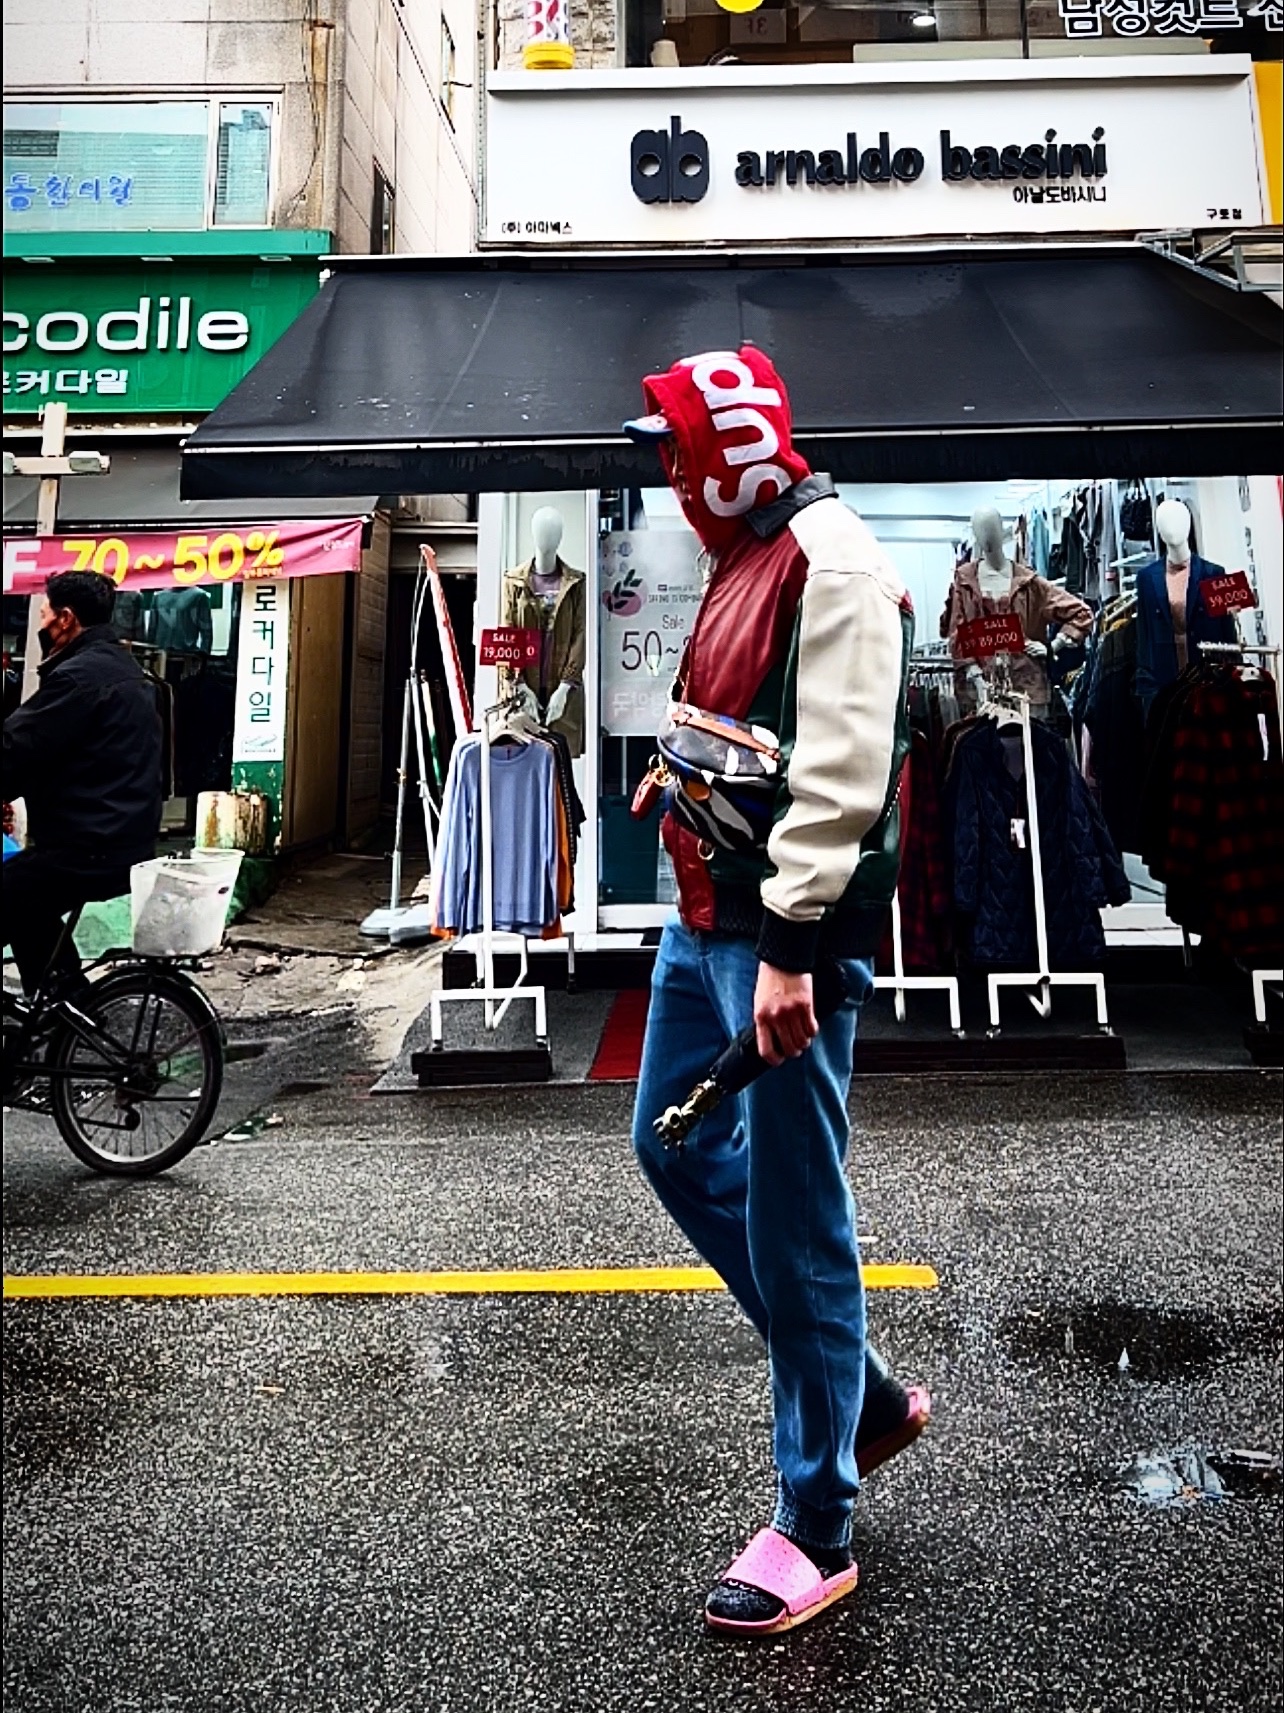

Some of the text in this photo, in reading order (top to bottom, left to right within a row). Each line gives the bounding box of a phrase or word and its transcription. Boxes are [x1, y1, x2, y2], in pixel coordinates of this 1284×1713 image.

[735, 126, 1107, 186] arnaldo bassini
[1012, 186, 1107, 203] 아날도바시니
[3, 369, 128, 394] 커다일
[492, 632, 516, 644] SALE
